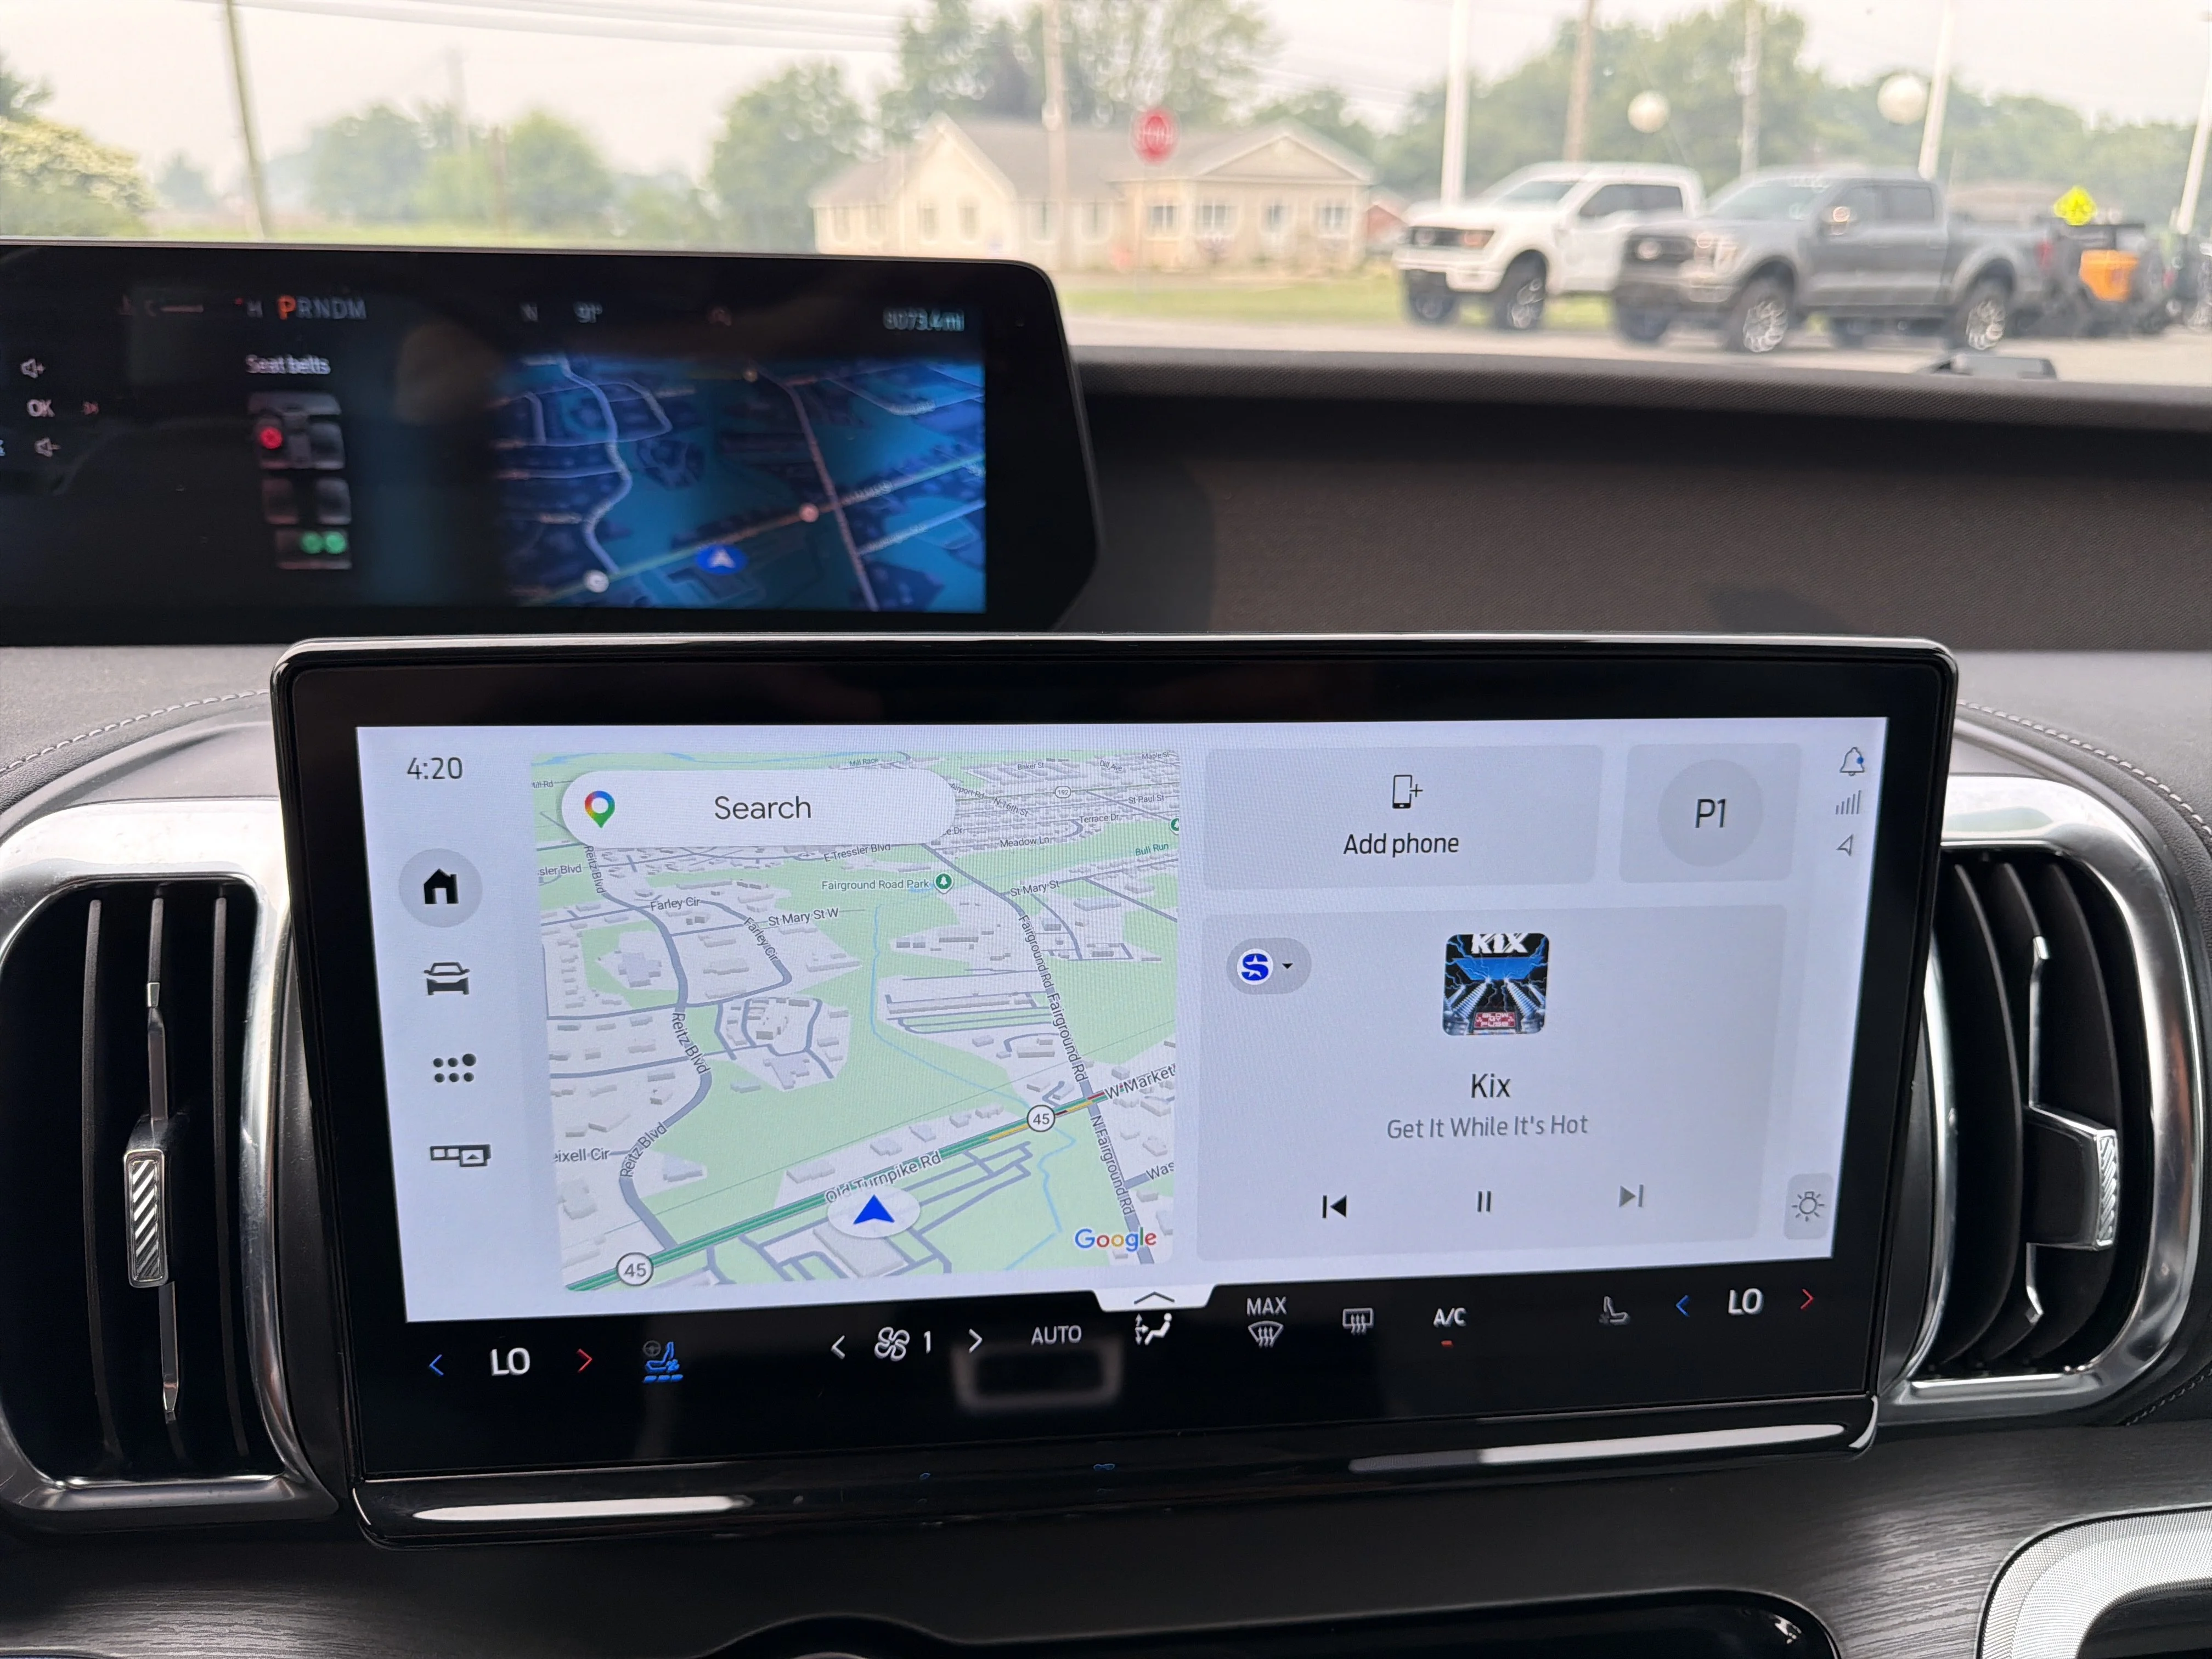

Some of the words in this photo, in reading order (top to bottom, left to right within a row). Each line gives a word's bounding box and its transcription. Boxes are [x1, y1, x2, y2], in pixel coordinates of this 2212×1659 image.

[27, 399, 55, 417] OK
[407, 757, 463, 780] 4:20
[1099, 760, 1110, 768] Dill
[1110, 763, 1122, 771] Ave
[543, 780, 554, 788] Rd
[950, 783, 974, 795] Airport
[974, 791, 985, 799] Rd
[714, 795, 811, 820] Search
[993, 797, 1001, 806] N
[1003, 801, 1019, 814] 16th
[1019, 809, 1029, 817] St
[1128, 796, 1136, 804] St
[1138, 795, 1155, 803] Paul
[1079, 815, 1109, 823] Terrace
[1695, 798, 1726, 828] P1
[953, 826, 963, 835] Dr
[1000, 837, 1039, 848] Meadow
[1040, 836, 1050, 845] Ln
[1135, 847, 1151, 856] Bull
[1153, 843, 1169, 853] Run
[1342, 833, 1387, 855] Add
[1392, 832, 1459, 858] phone
[823, 854, 831, 862] E
[832, 846, 868, 860] Tressler
[871, 843, 891, 854] Blvd
[560, 864, 582, 874] Blvd
[584, 845, 597, 871] Reitz
[592, 871, 607, 894] Blvd
[822, 880, 876, 892] Fairground
[879, 879, 904, 889] Road
[907, 879, 929, 888] Park
[1009, 887, 1021, 897] St
[1023, 883, 1047, 895] Mary
[1048, 880, 1060, 890] St
[651, 898, 683, 911] Farley
[685, 896, 701, 907] Cir
[768, 916, 780, 926] St
[782, 912, 810, 924] Mary
[813, 909, 825, 919] St
[827, 907, 839, 918] W
[743, 917, 769, 946] Farley
[765, 947, 778, 961] Cir
[1018, 914, 1049, 972] Fairground
[1041, 973, 1054, 988] Rd
[672, 1011, 690, 1045] Reitz
[685, 1045, 711, 1075] Blvd
[1047, 992, 1081, 1062] Fairground
[1071, 1063, 1089, 1082] Rd
[1104, 1085, 1120, 1099] W
[1123, 1065, 1175, 1094] Market
[1470, 1073, 1511, 1098] Kix
[1032, 1113, 1050, 1125] 45
[1091, 1115, 1104, 1127] N
[1387, 1119, 1424, 1139] Get
[1429, 1118, 1444, 1138] It
[1450, 1116, 1508, 1137] While
[1514, 1115, 1545, 1136] It's
[1550, 1114, 1588, 1135] Hot
[591, 1147, 611, 1161] Cir
[620, 1146, 643, 1178] Reitz
[638, 1122, 667, 1150] Blvd
[854, 1161, 918, 1188] Turnpike
[920, 1150, 941, 1169] Rd
[1094, 1128, 1128, 1197] Fairground
[1119, 1197, 1136, 1215] Rd
[1074, 1227, 1157, 1252] Google
[624, 1262, 647, 1277] 45
[1245, 1296, 1288, 1316] MAX
[1728, 1287, 1765, 1316] LO
[1432, 1307, 1468, 1328] A/C
[923, 1330, 932, 1354] 1
[1030, 1325, 1082, 1346] AUTO
[489, 1347, 531, 1377] LO
